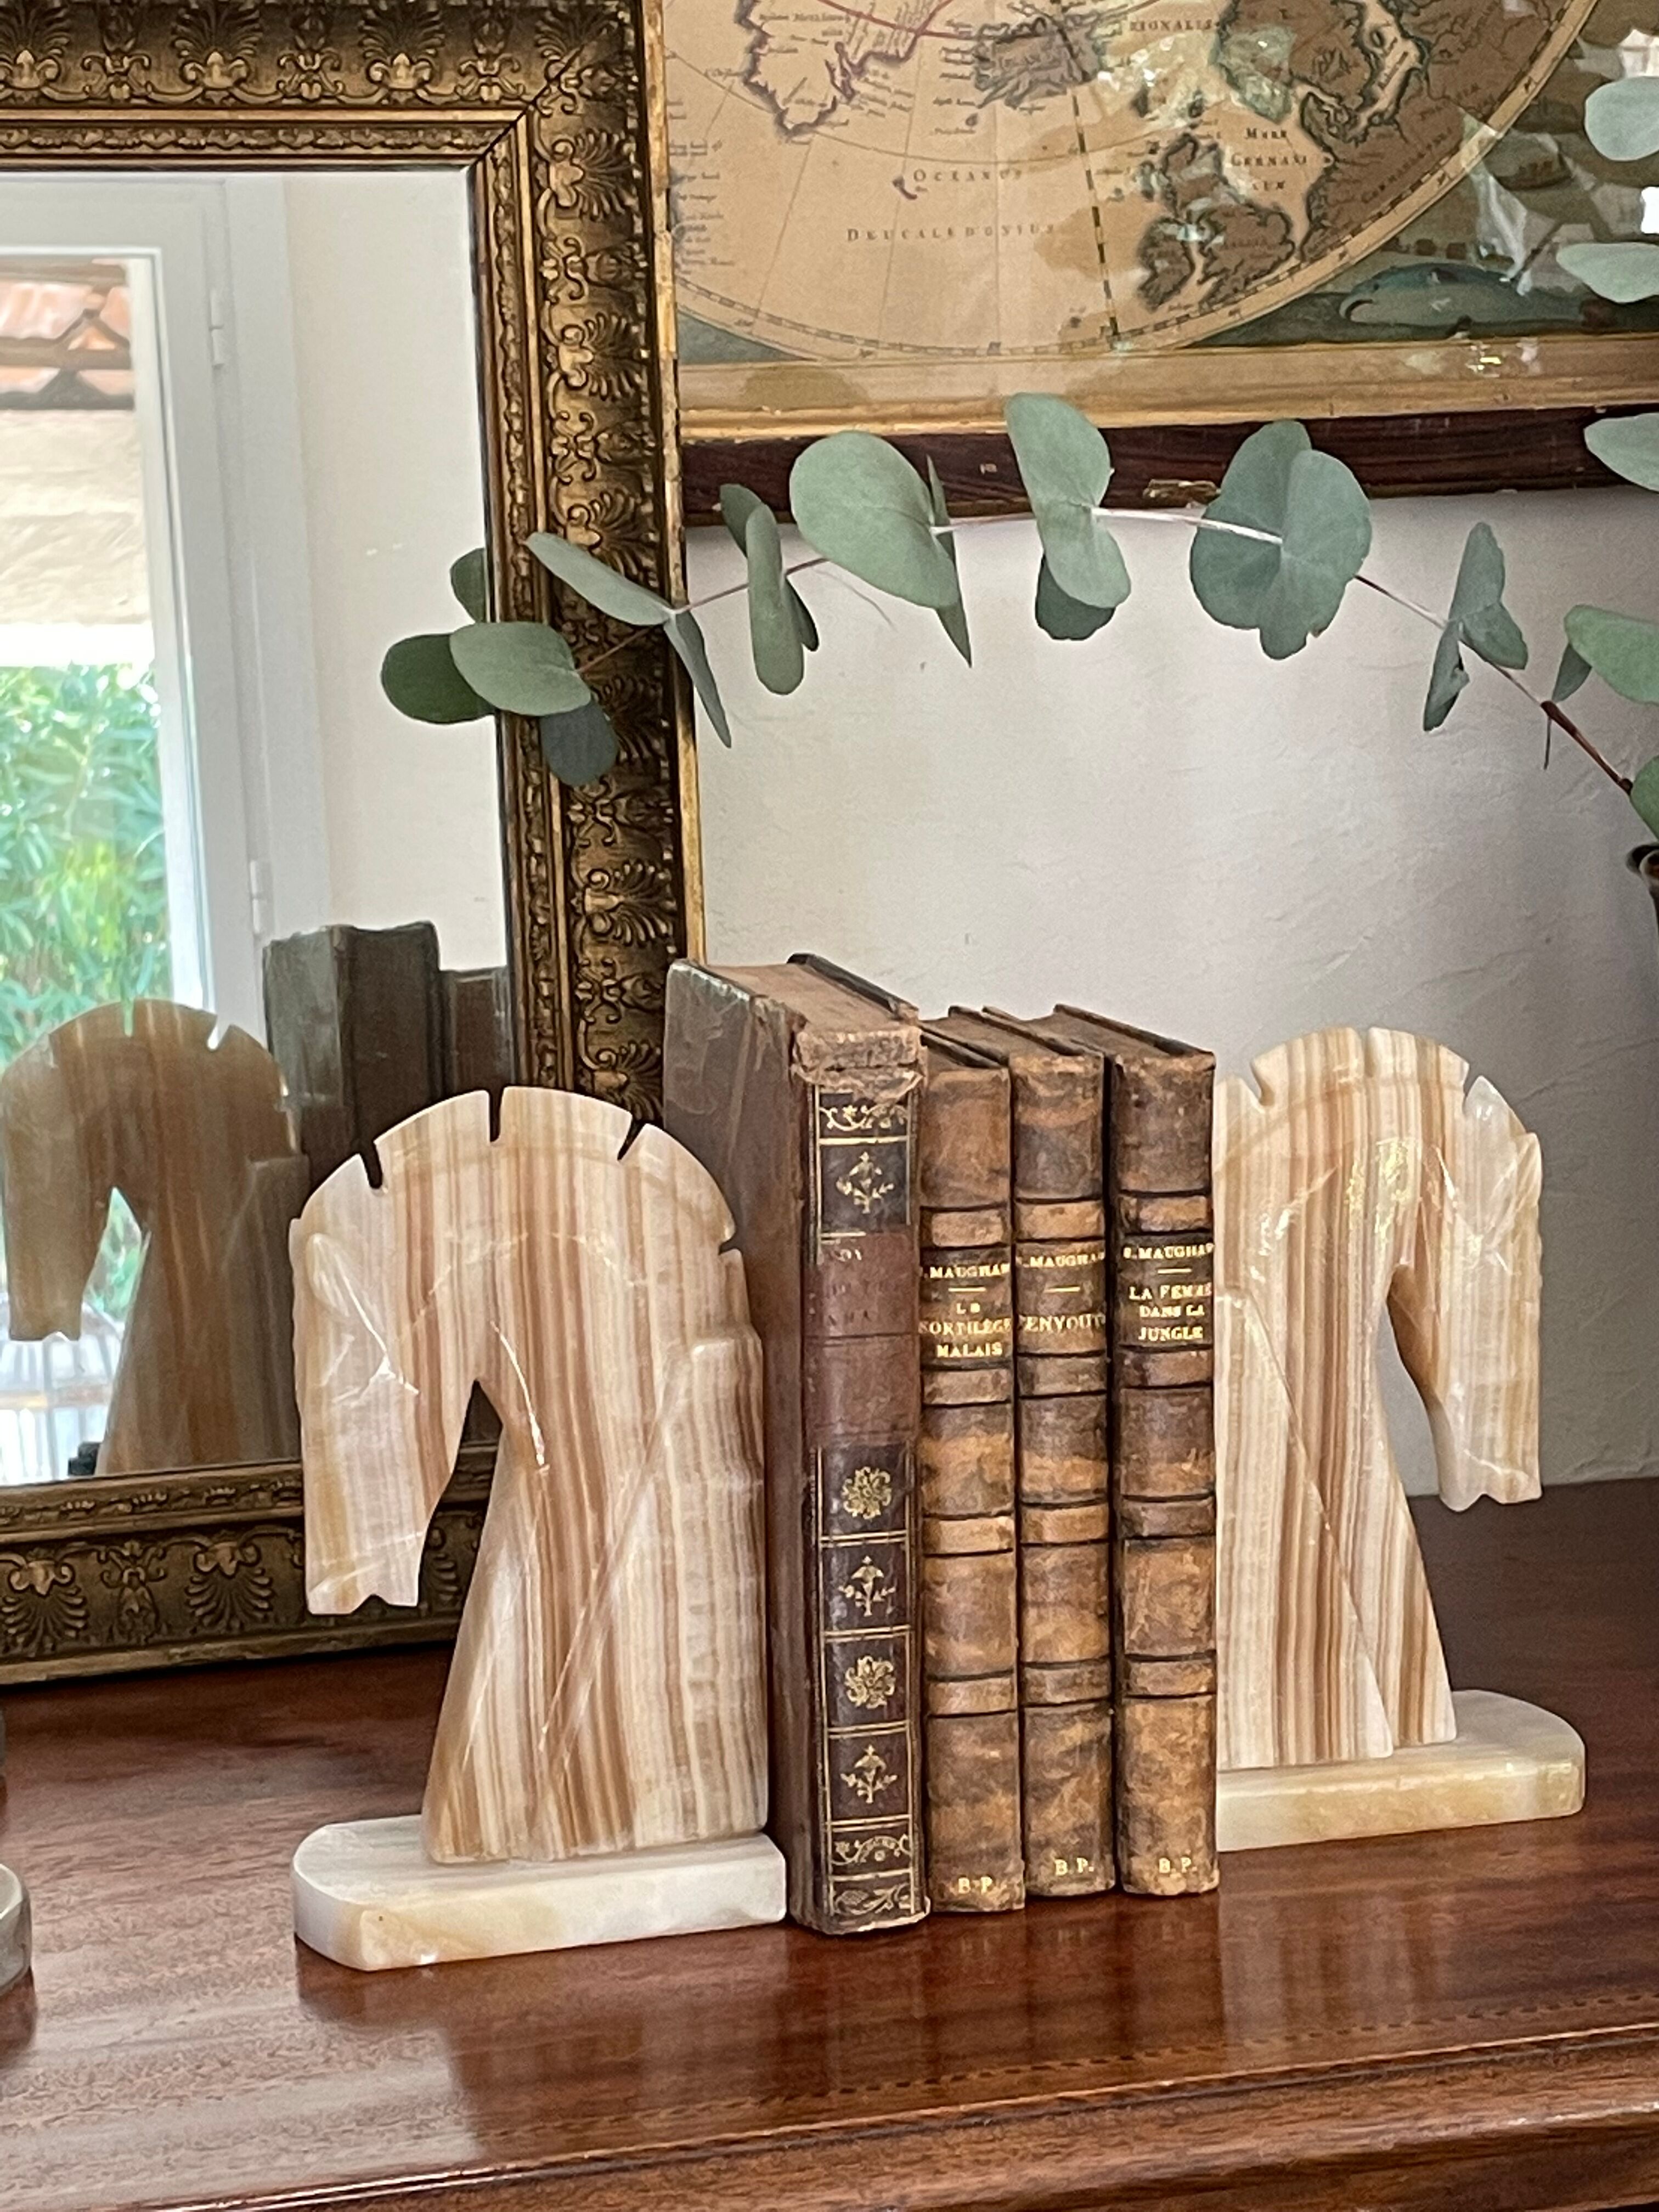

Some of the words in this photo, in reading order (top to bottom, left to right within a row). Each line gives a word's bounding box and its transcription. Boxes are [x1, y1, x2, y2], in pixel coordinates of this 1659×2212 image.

[1129, 1286, 1152, 1300] LA
[1139, 1305, 1181, 1317] DANS
[1186, 1304, 1205, 1316] LA
[1138, 1325, 1204, 1341] JUNGLE
[937, 1342, 1003, 1358] MALAIS
